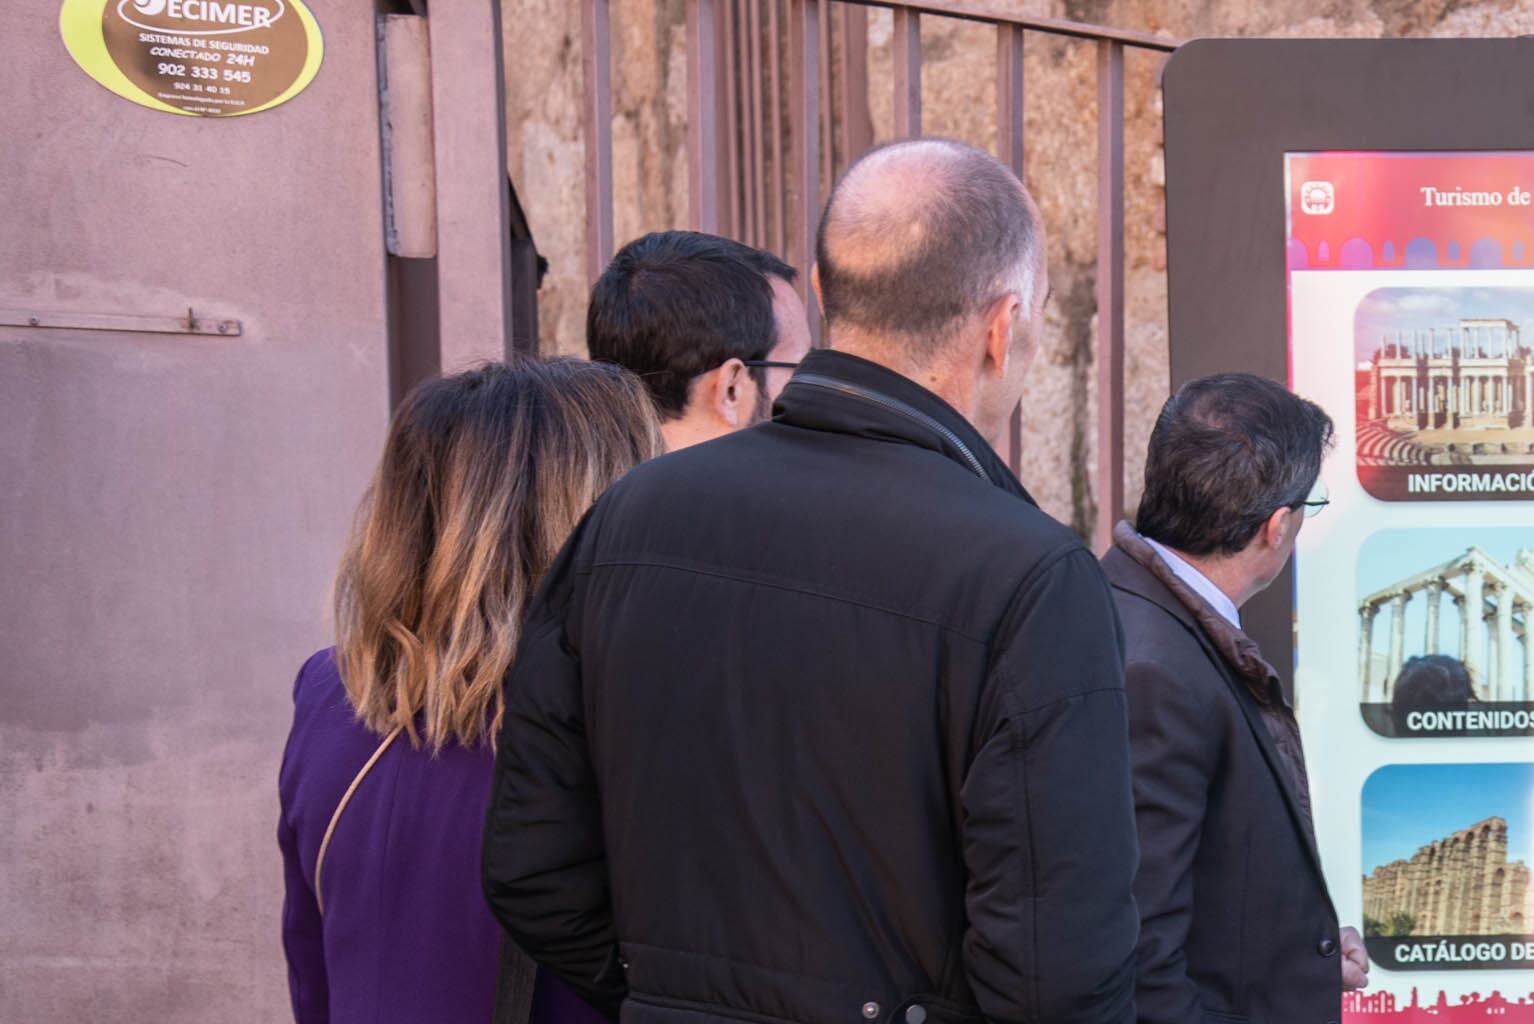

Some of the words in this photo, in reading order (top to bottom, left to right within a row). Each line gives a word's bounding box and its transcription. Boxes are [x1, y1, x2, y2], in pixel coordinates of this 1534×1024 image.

[139, 33, 191, 47] SISTEMAS
[193, 38, 206, 49] DE
[208, 39, 270, 55] SEGURIDAD
[149, 46, 221, 62] CONECTADO
[226, 53, 255, 67] 24H
[157, 62, 186, 77] 902
[190, 66, 218, 80] 333
[223, 69, 251, 83] 545
[1420, 186, 1502, 206] Turismo
[1507, 186, 1531, 205] de
[1394, 940, 1506, 962] CATÁLOGO
